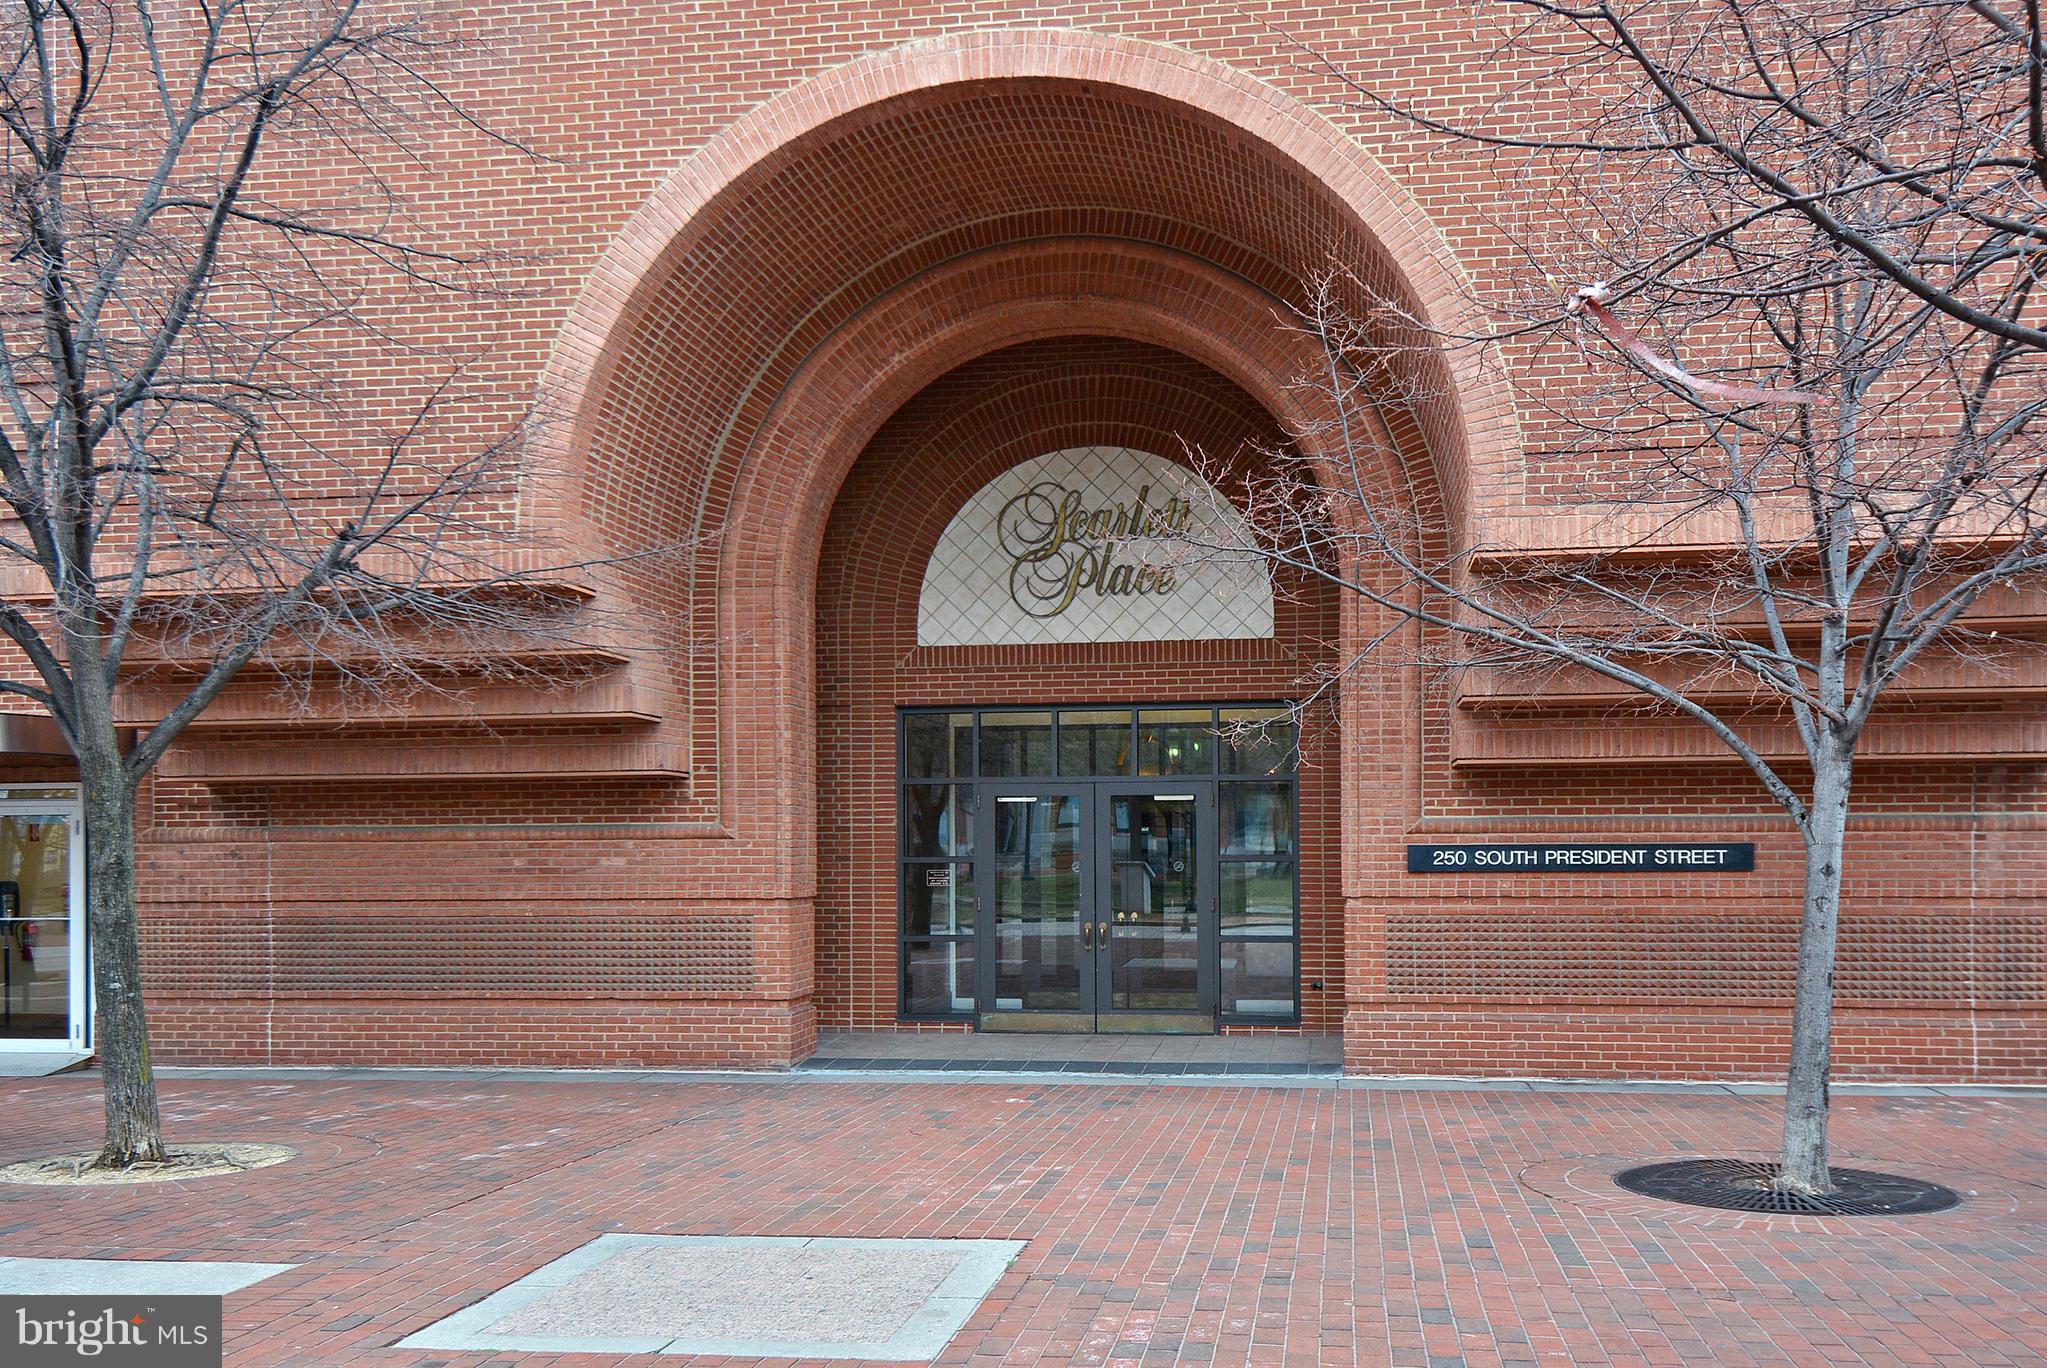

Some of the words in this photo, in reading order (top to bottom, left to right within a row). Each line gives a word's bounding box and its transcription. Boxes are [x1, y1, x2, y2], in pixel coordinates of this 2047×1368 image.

[1009, 538, 1176, 619] Place
[1433, 850, 1467, 865] 250
[1474, 850, 1538, 865] SOUTH
[1545, 849, 1647, 865] PRESIDENT
[1654, 849, 1728, 864] STREET
